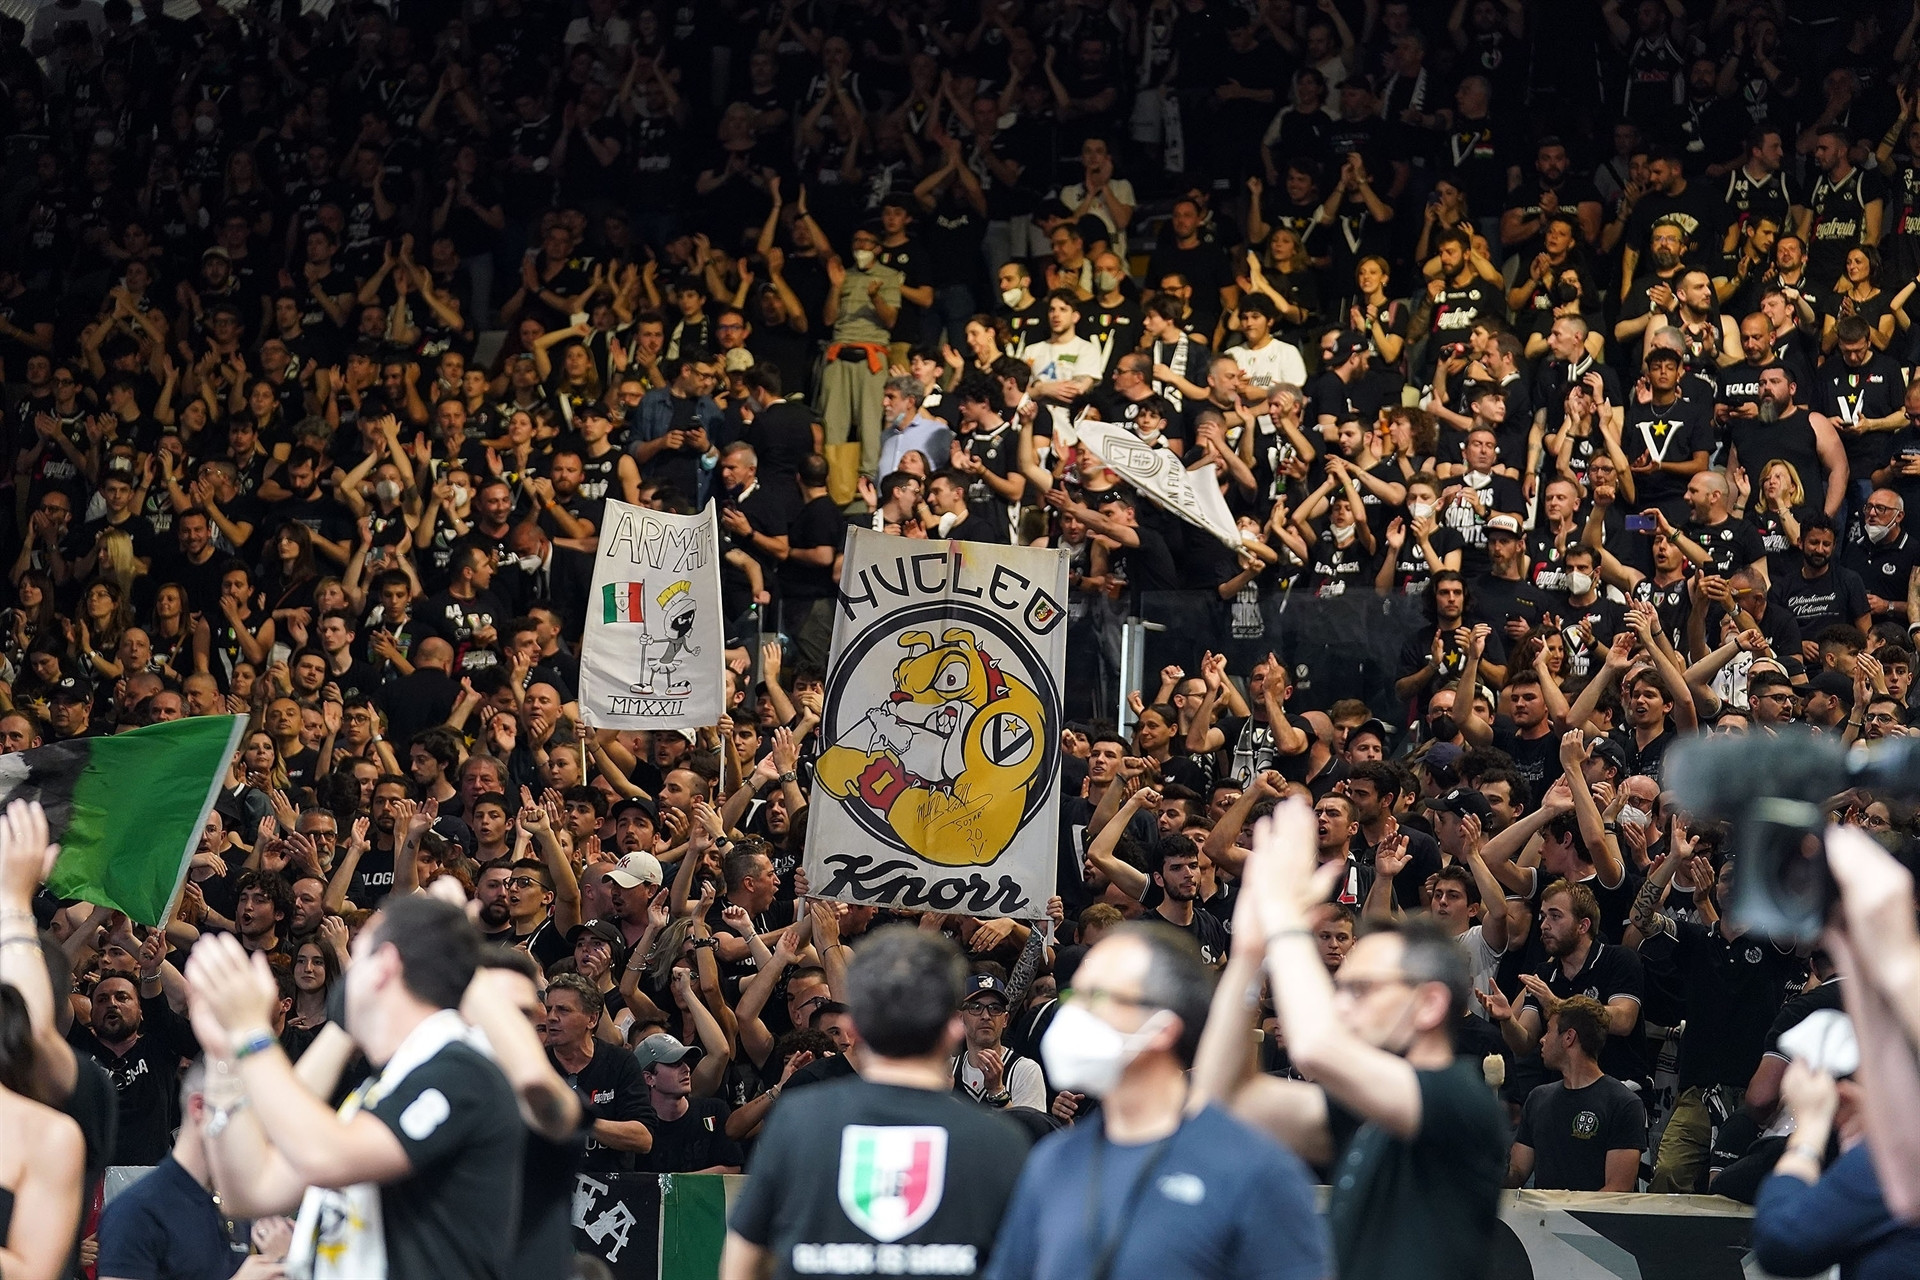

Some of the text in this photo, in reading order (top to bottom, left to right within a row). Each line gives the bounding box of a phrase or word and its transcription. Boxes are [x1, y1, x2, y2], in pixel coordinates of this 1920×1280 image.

[1726, 382, 1759, 397] BOLOG
[611, 696, 684, 716] MMXXII
[818, 854, 1029, 913] Knorr
